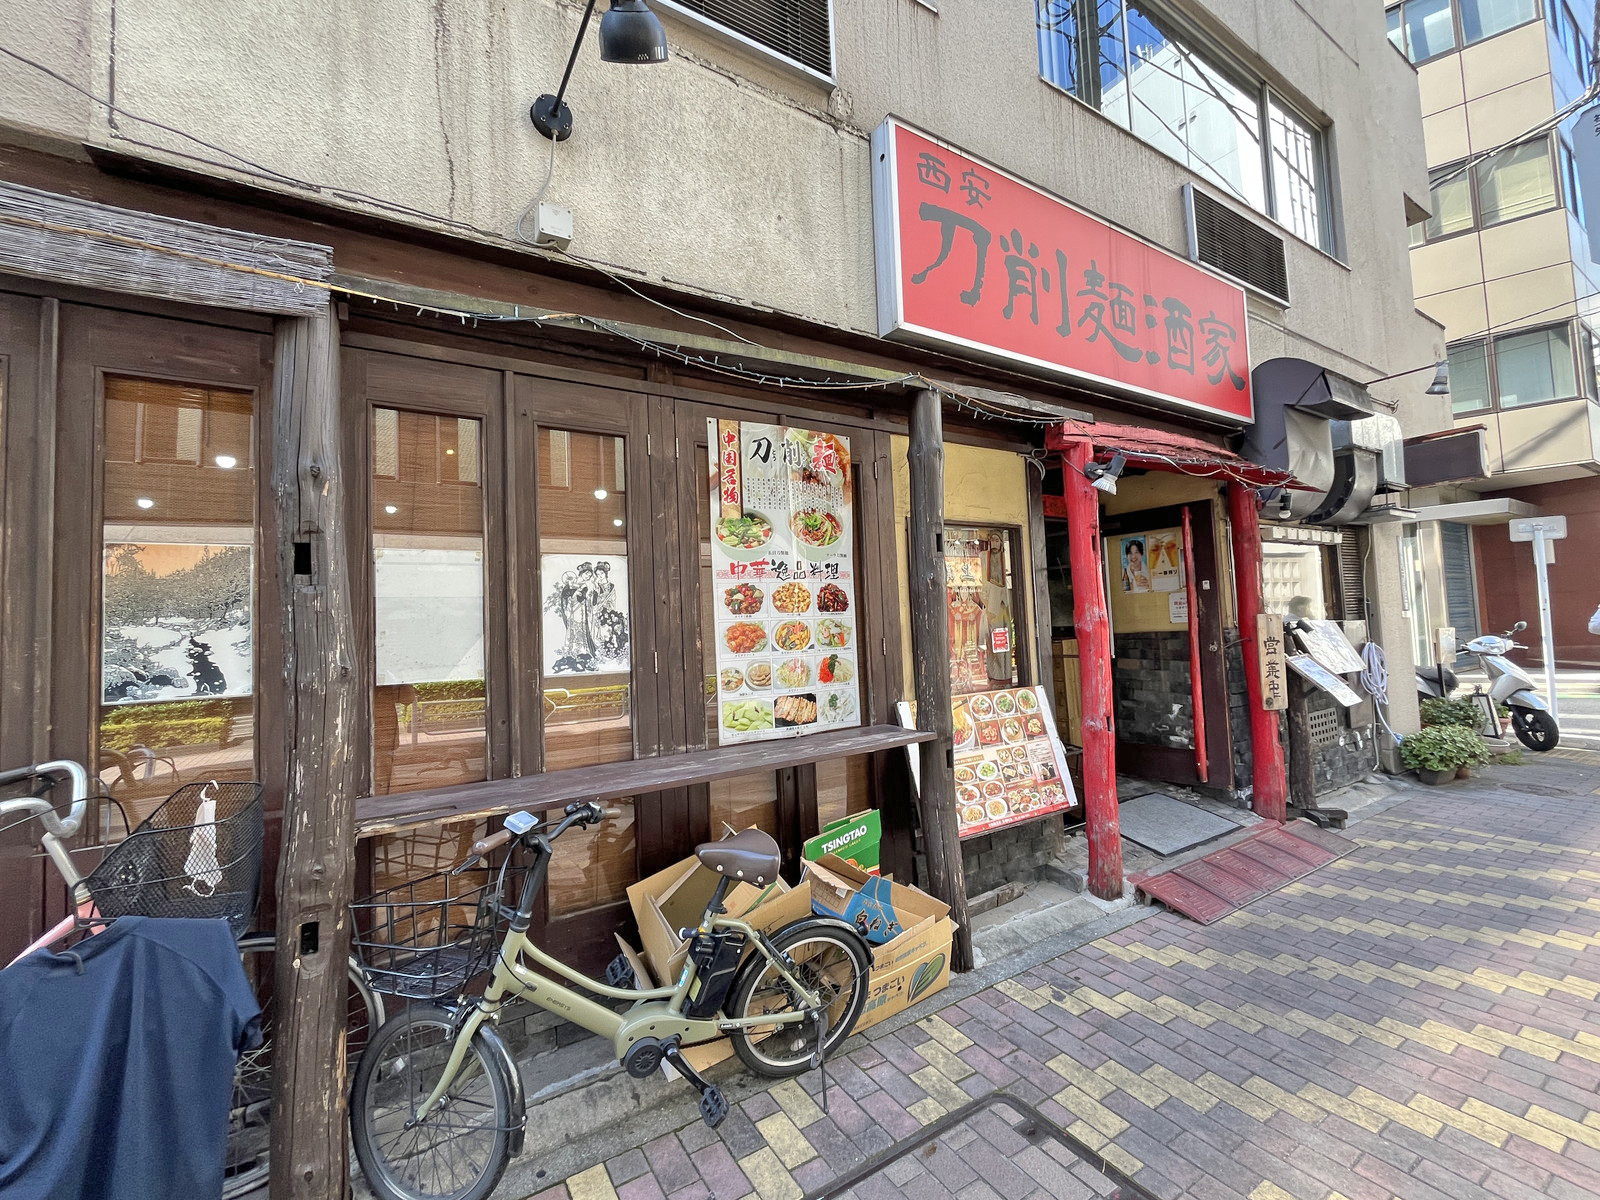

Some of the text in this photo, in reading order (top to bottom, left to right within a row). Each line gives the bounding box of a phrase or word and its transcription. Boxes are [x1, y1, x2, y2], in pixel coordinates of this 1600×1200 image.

[916, 152, 992, 208] 西安
[911, 202, 1246, 391] 刀削麺酒家
[722, 430, 739, 504] 中国名物
[1263, 635, 1282, 699] 営業中
[821, 825, 867, 854] TSINGTAO
